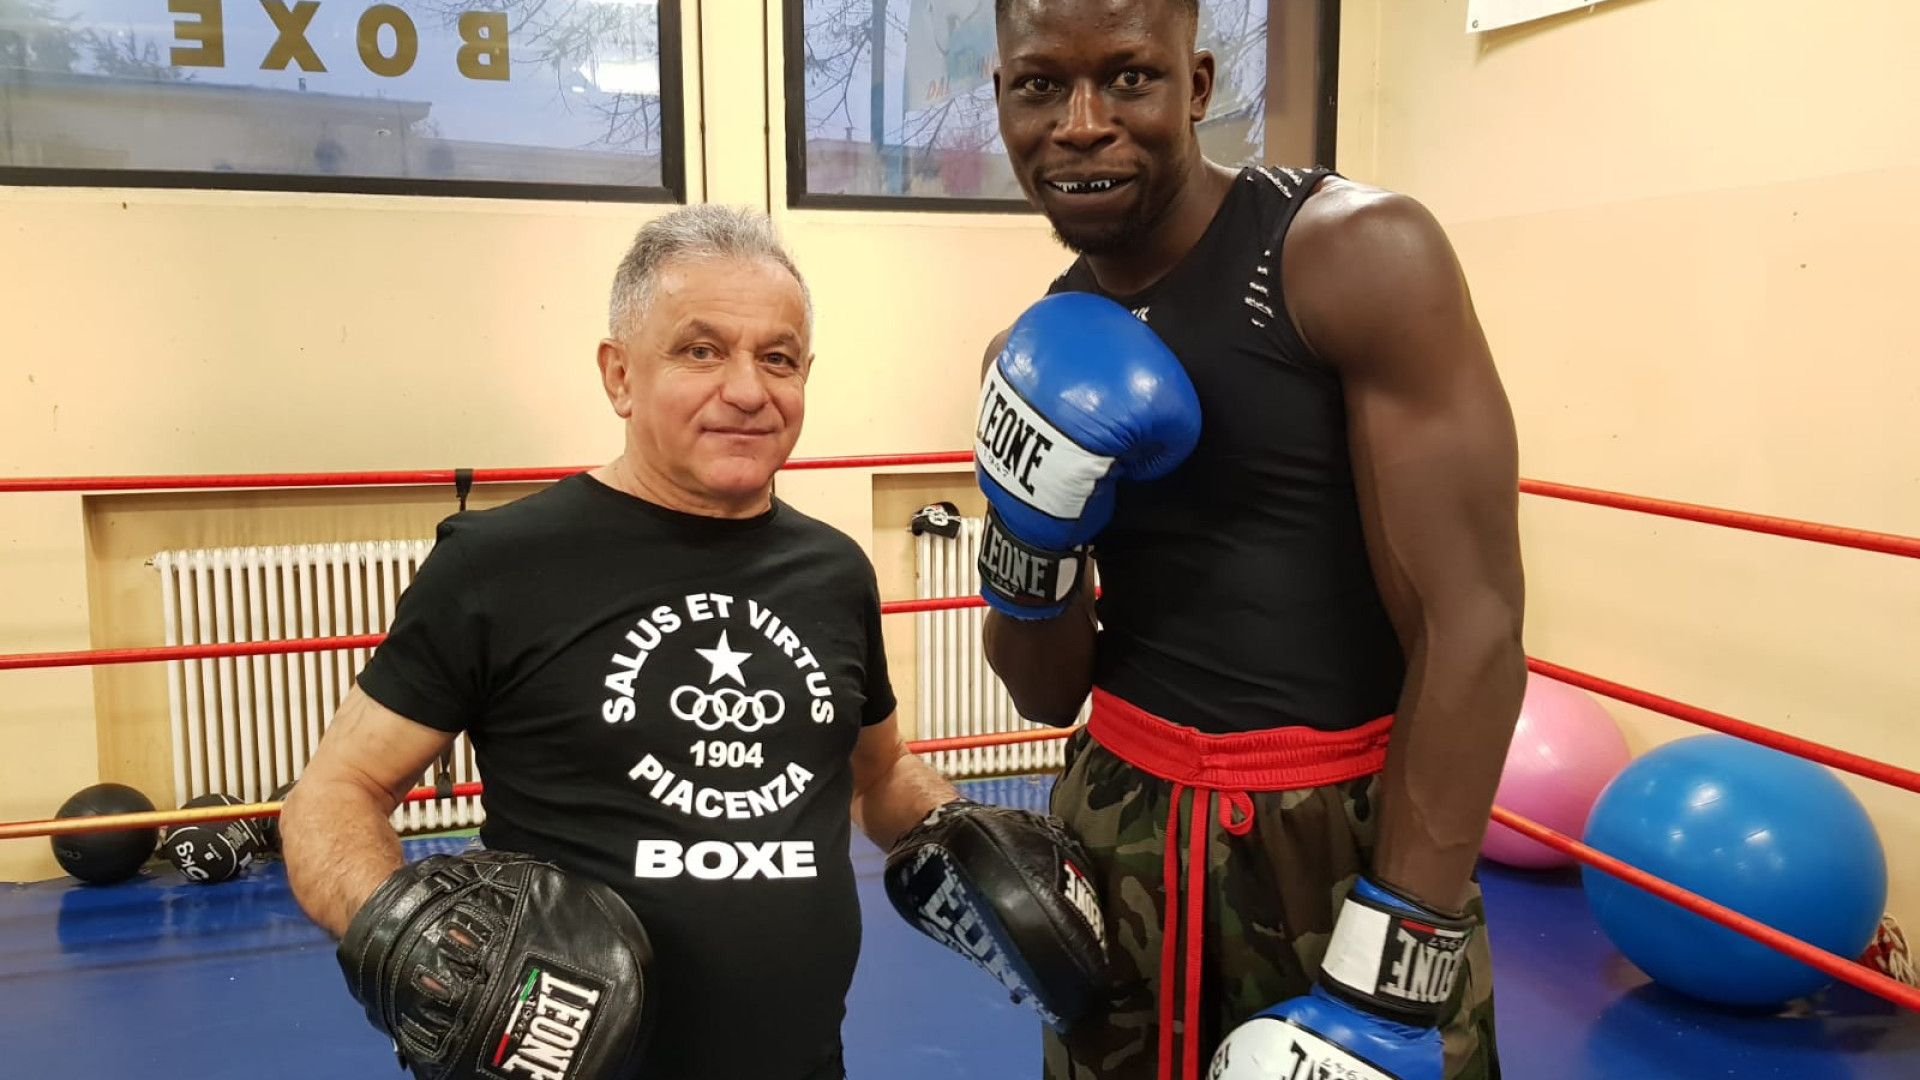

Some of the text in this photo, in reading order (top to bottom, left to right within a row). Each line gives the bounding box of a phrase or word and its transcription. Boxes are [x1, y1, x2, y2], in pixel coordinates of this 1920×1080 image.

[976, 380, 1054, 497] LEONE
[980, 514, 1048, 598] LEONE
[602, 593, 834, 724] SALUS ET VIRTUS
[628, 753, 815, 819] PIACENZA
[690, 740, 764, 768] 1904
[635, 839, 818, 880] BOXE
